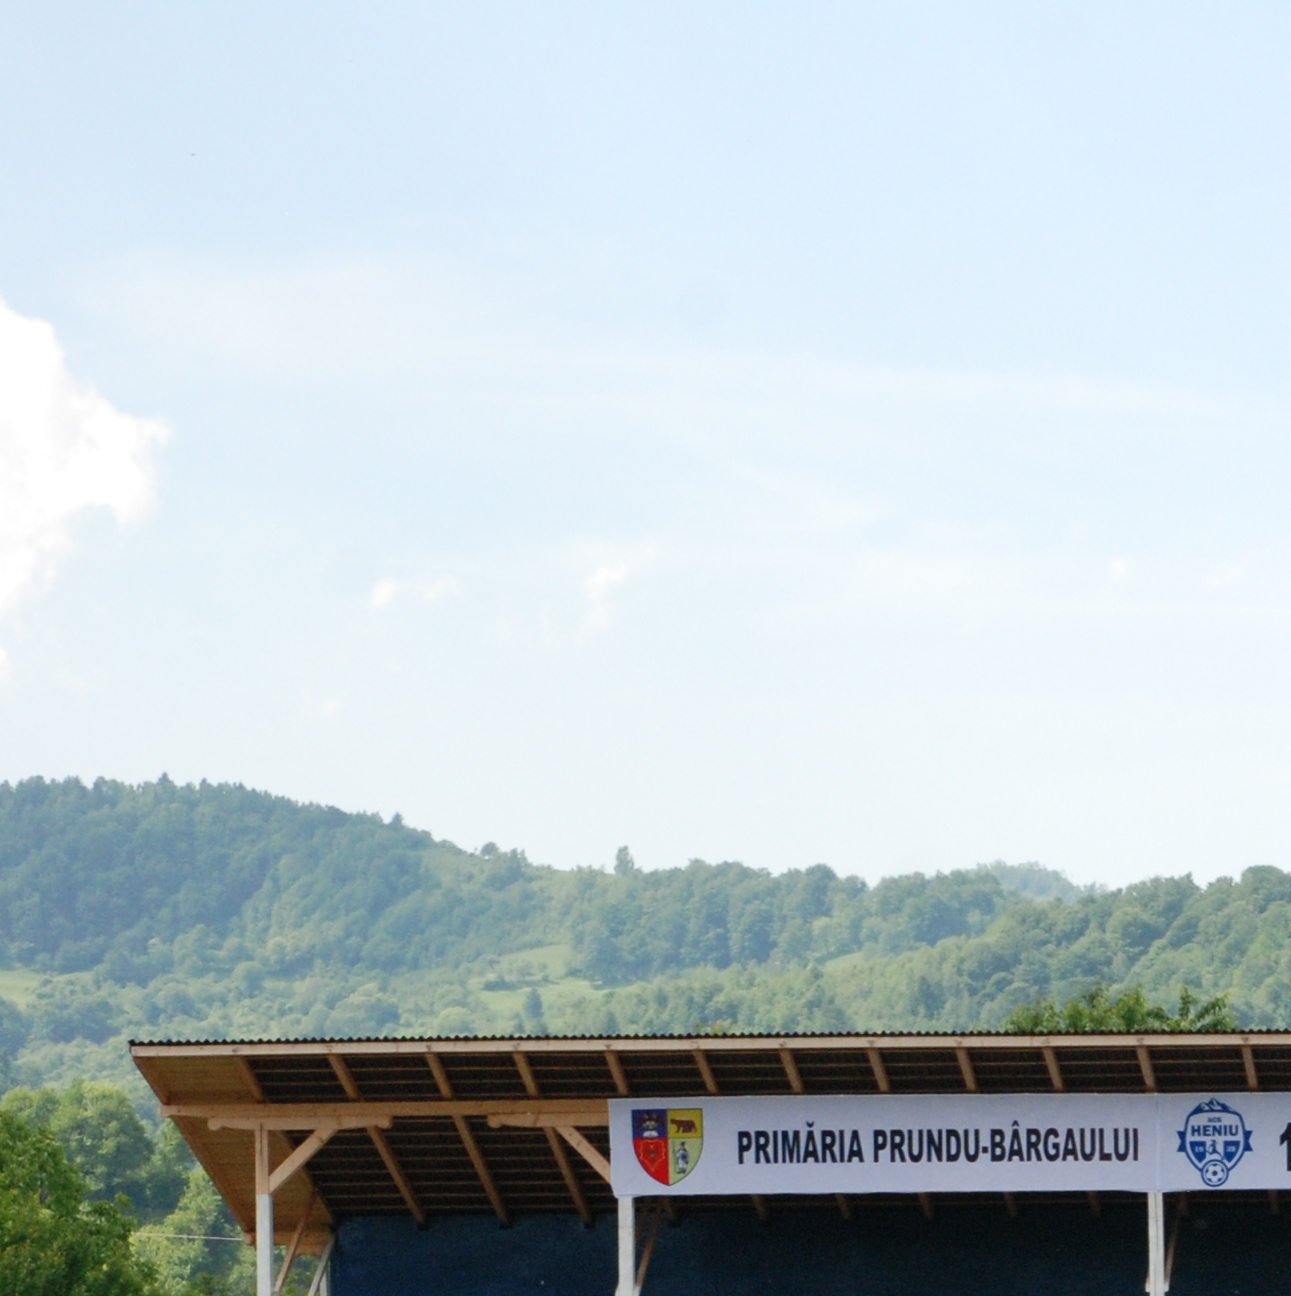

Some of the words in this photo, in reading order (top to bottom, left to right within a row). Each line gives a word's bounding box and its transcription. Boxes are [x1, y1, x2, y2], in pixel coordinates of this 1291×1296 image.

[737, 1120, 865, 1164] PRIMĂRIA
[873, 1120, 1139, 1163] PRUNDU-BÂRGAULUI
[1191, 1125, 1239, 1136] HENIU
